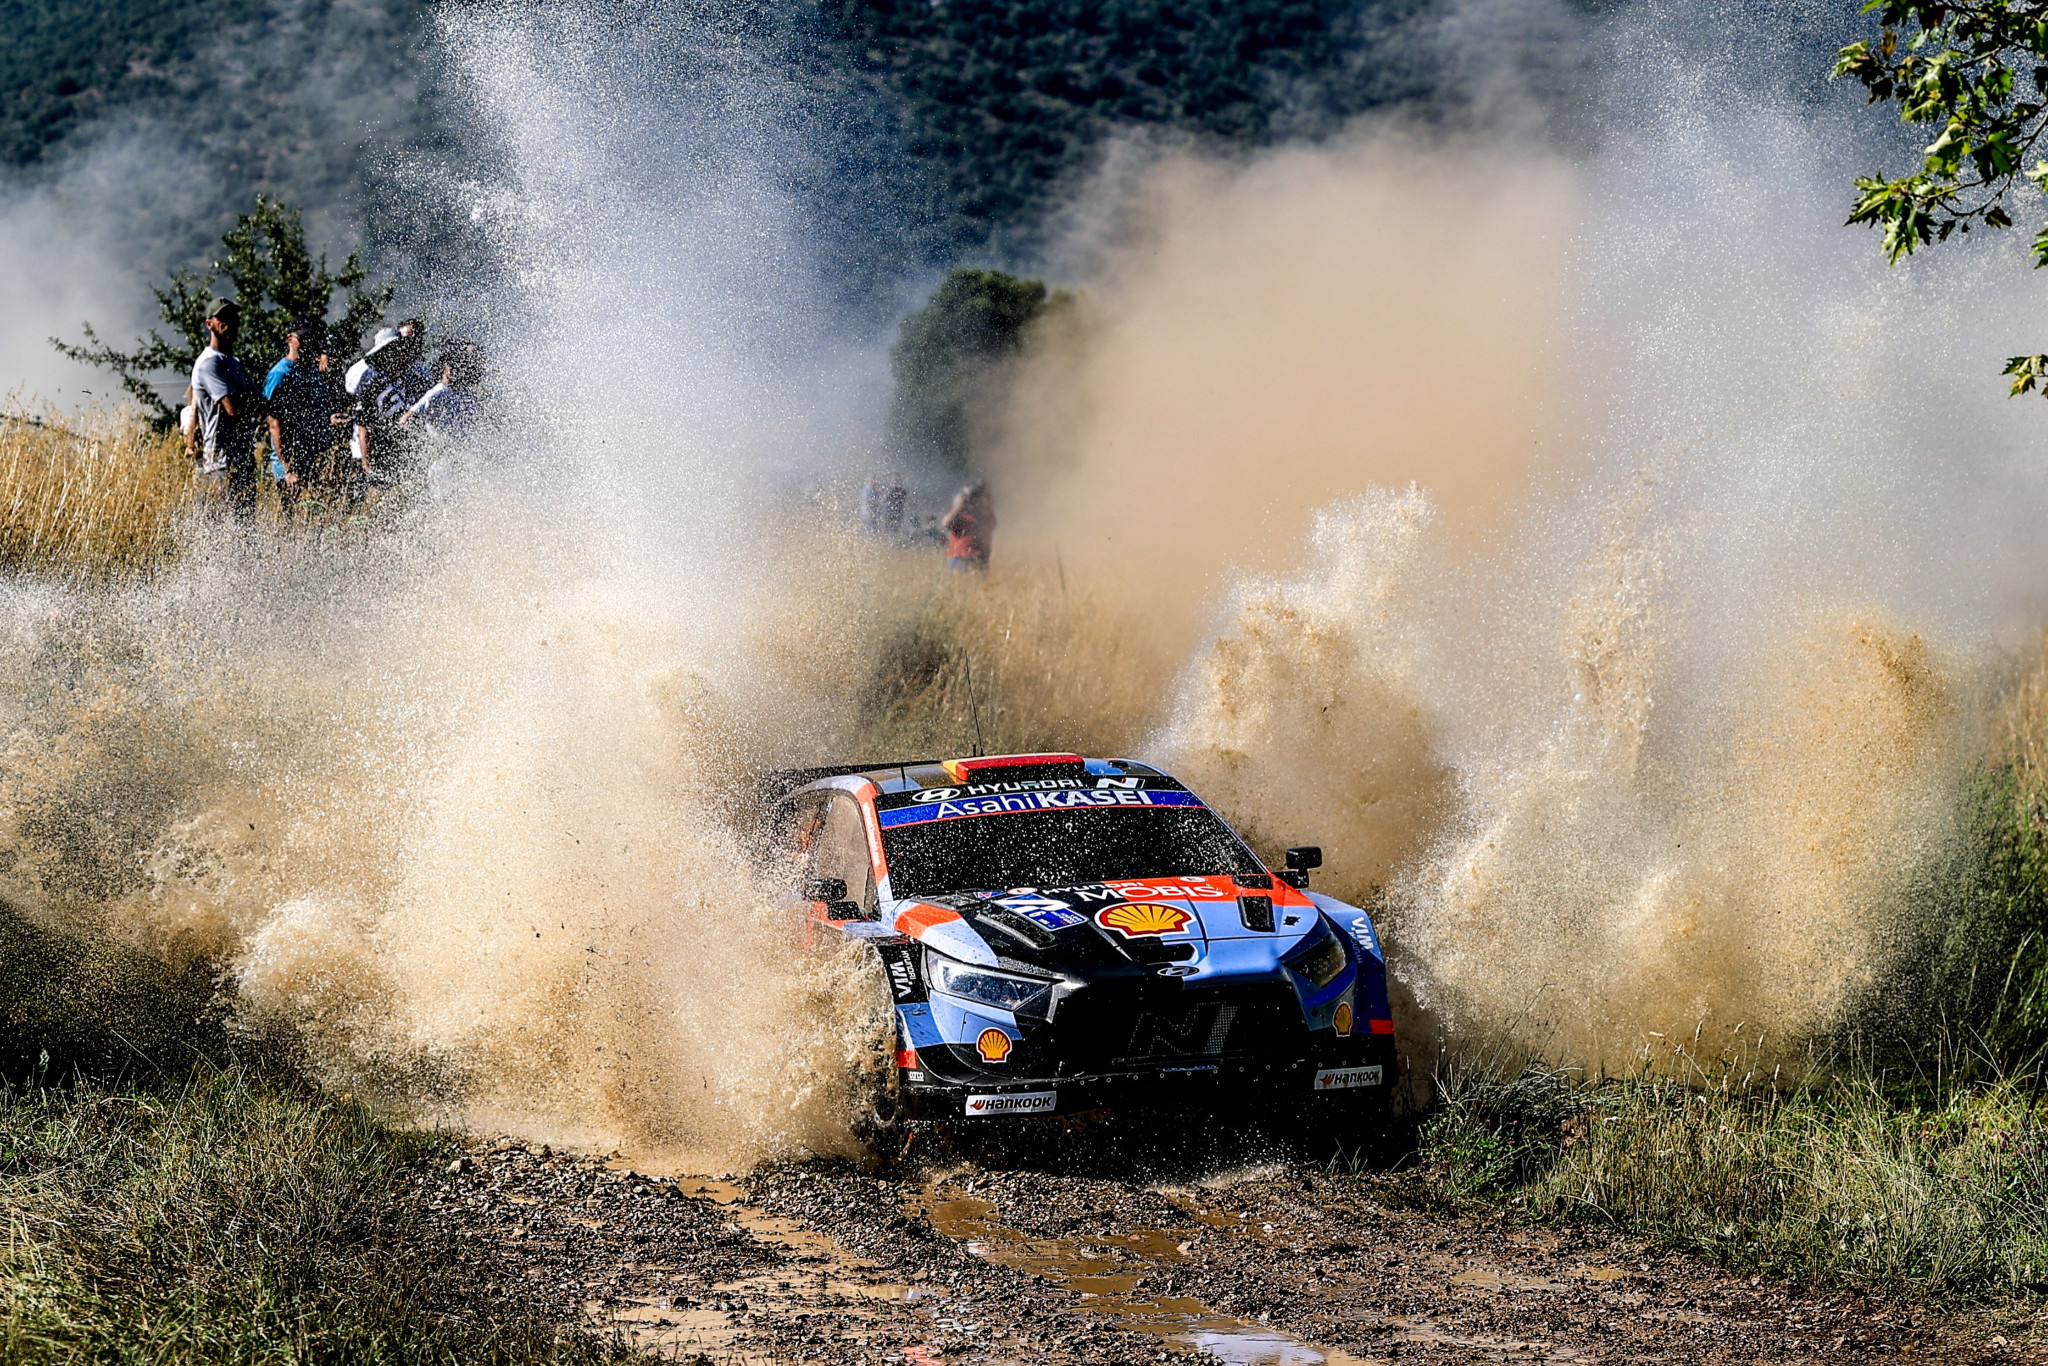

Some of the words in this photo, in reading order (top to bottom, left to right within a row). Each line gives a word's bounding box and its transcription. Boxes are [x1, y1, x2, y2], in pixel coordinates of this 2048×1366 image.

[967, 779, 1084, 796] HYUNDAI
[936, 789, 1154, 819] AsahiKASEI
[1041, 882, 1145, 895] HYUNDAI
[1074, 885, 1225, 902] MOBIS
[900, 950, 917, 980] HYUNDAI
